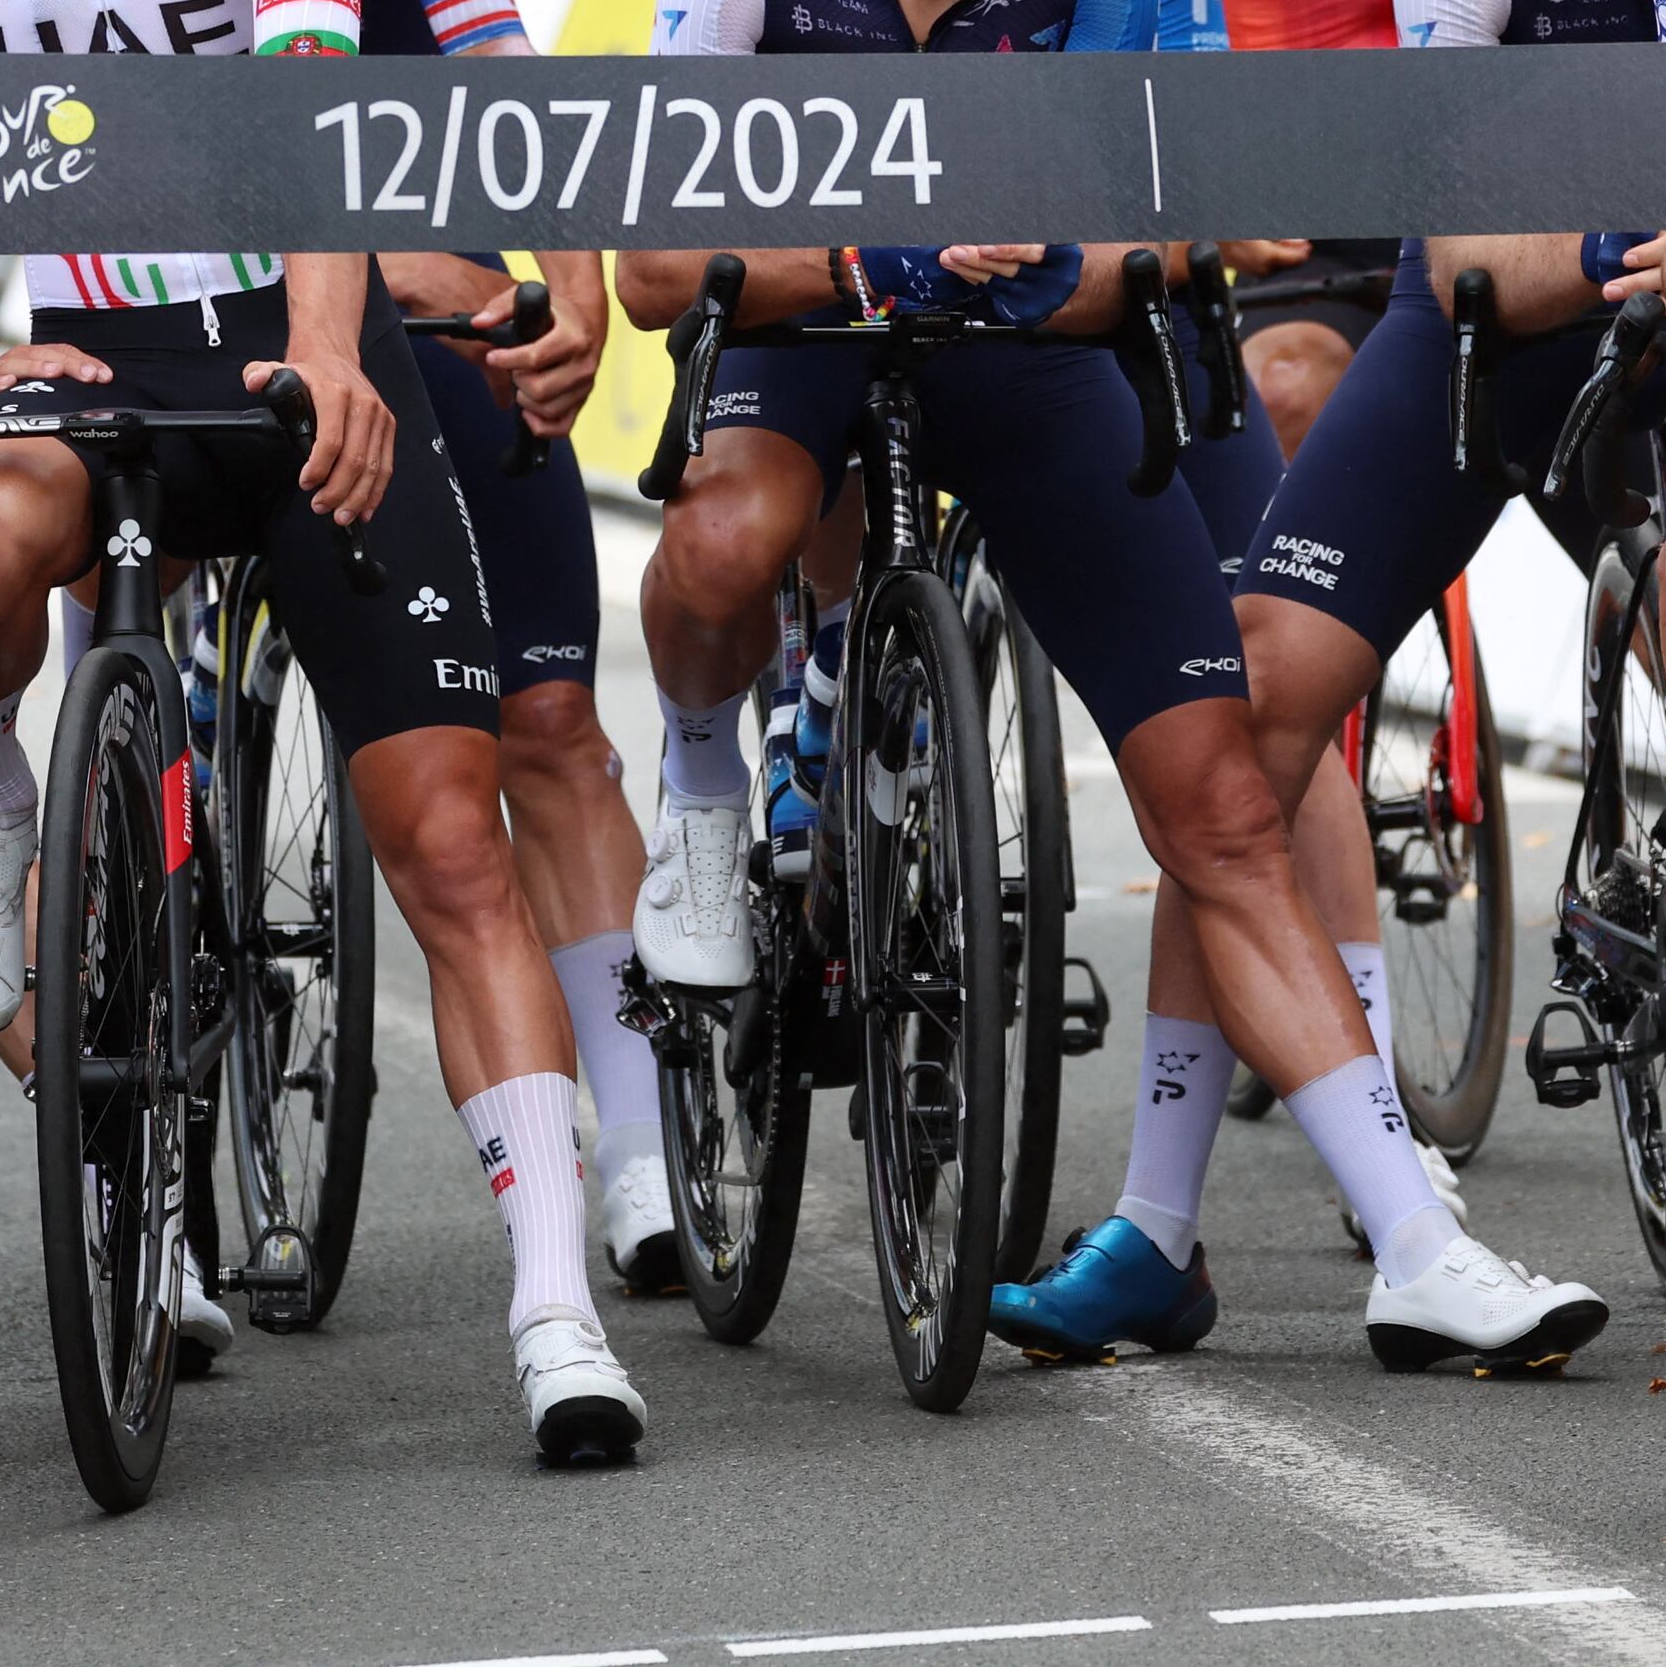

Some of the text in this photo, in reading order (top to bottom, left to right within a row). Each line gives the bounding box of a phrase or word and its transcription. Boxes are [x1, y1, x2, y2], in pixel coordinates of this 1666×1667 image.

[817, 17, 864, 38] BLACK
[1556, 16, 1599, 32] BLACK
[26, 134, 52, 159] de
[316, 84, 943, 227] 12/07/2024
[69, 428, 119, 440] wahoo
[887, 415, 916, 550] FACTOR
[1271, 533, 1346, 566] RACING
[1291, 551, 1314, 564] FOR
[1258, 557, 1340, 592] CHANGE
[182, 759, 194, 846] Emirates
